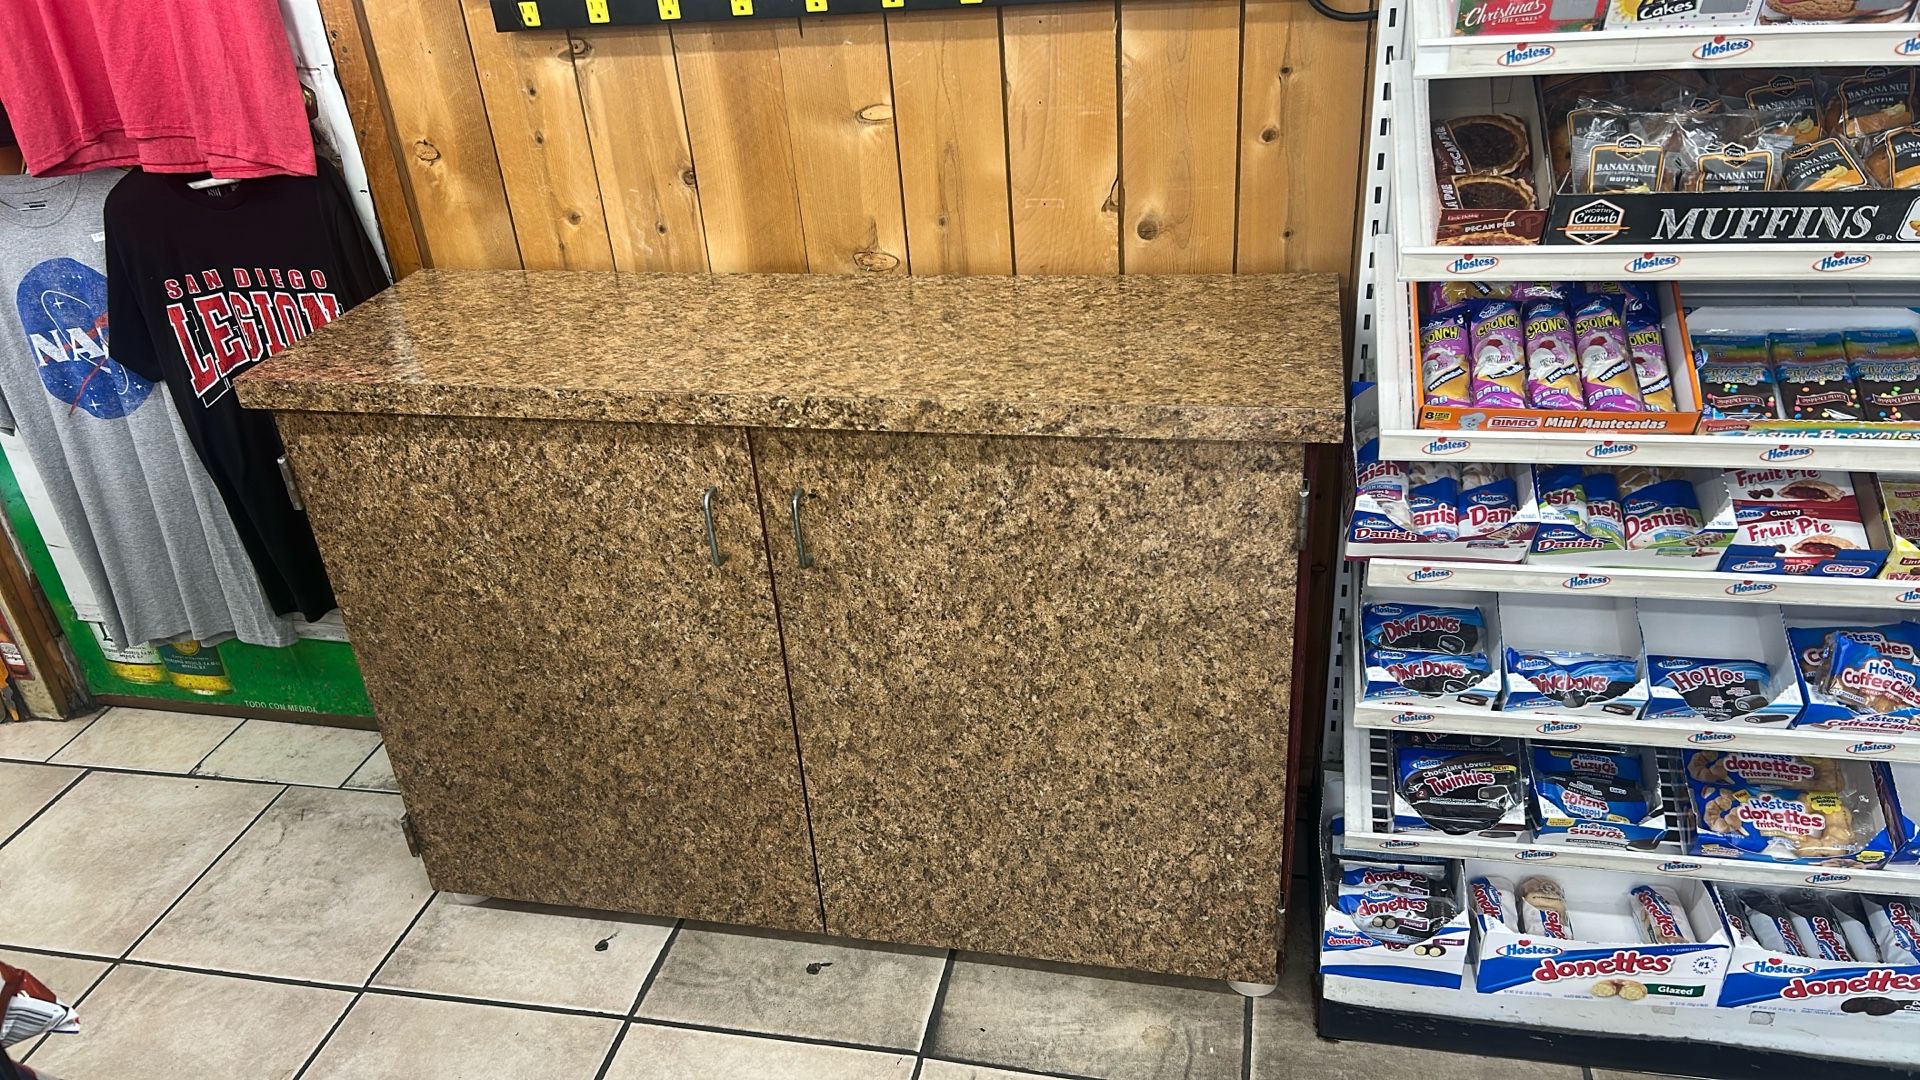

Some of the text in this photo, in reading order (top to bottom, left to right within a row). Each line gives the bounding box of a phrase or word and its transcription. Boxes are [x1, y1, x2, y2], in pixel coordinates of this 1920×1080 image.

[1639, 1, 1695, 20] Cakes
[1702, 39, 1749, 58] Hostess
[1506, 48, 1552, 65] Hostess
[1847, 83, 1909, 99] BANANA NUT
[1596, 163, 1657, 173] BANANA NUT
[1799, 162, 1830, 180] MUFFIN
[1705, 170, 1766, 181] BANANA NUT
[1574, 211, 1617, 224] Crumb
[1651, 205, 1880, 240] MUFFINS
[1465, 221, 1516, 233] PECAN PIES
[1455, 257, 1496, 272] Hostess
[1633, 255, 1677, 272] Hostess
[1822, 255, 1867, 270] Hostess
[164, 267, 328, 299] SAN DIEGO
[1476, 315, 1520, 338] SPONCH
[1574, 313, 1621, 337] SPONCH
[1629, 331, 1661, 346] ONCH
[29, 327, 109, 367] NA
[1716, 395, 1761, 405] Little Debbie
[1800, 393, 1847, 404] Little Debbie
[1425, 412, 1435, 421] 8
[1491, 417, 1666, 430] BIMBO Mini Mantecadas
[1430, 441, 1468, 454] Hostess
[1595, 444, 1634, 458] Hostess
[1768, 447, 1810, 460] Hostess
[1358, 460, 1400, 486] nish
[1735, 469, 1784, 487] Fruit
[1476, 494, 1506, 502] Hostess
[1413, 503, 1460, 527] anis
[1470, 504, 1517, 527] Dani
[1769, 509, 1802, 517] Cherry
[1625, 509, 1699, 540] Danish
[1747, 517, 1832, 542] Fruit Pie
[1355, 528, 1417, 541] Danish
[1539, 538, 1603, 551] Danish
[1740, 563, 1773, 572] Hostess
[1826, 565, 1866, 575] Cherry
[1414, 569, 1451, 581] Hostess
[1570, 575, 1608, 588] Hostess
[1733, 582, 1774, 594] Hostess
[1375, 606, 1401, 614] Hostess
[1417, 615, 1460, 633] DONGS
[1422, 660, 1466, 678] DONGS
[1520, 660, 1549, 668] Hostess
[1868, 662, 1915, 685] Hostess
[1565, 674, 1607, 692] DONGS
[244, 700, 267, 709] TODO
[269, 702, 286, 711] CON
[1398, 713, 1432, 723] Hostess
[1867, 716, 1906, 724] ostess
[1544, 723, 1578, 733] Hostess
[1695, 733, 1732, 743] Hostess
[1854, 743, 1892, 753] Hostess
[1416, 760, 1441, 769] Hostess
[1422, 761, 1492, 778] Chocolate Lovers
[1726, 757, 1812, 776] donettes
[1741, 770, 1799, 782] fritter rings
[1425, 770, 1495, 796] Twinkies
[1568, 805, 1601, 818] Hostess
[1750, 799, 1804, 813] Hostess
[1739, 805, 1825, 829] donettes
[1755, 820, 1810, 836] fritter rings
[1522, 851, 1555, 860] Hostess
[1664, 862, 1699, 872] Hostess
[1364, 870, 1428, 885] donettes
[1813, 873, 1849, 884] Hostess
[1367, 890, 1392, 898] Hostess
[1358, 897, 1427, 916] donettes
[1333, 927, 1357, 935] Hostess
[1403, 920, 1423, 929] Frosted
[1328, 936, 1373, 946] donettes
[1505, 943, 1560, 957] Hostess
[1535, 952, 1672, 982] donettes
[1698, 961, 1710, 969] #1
[1754, 961, 1810, 975] Hostess
[1657, 985, 1694, 996] Glazed
